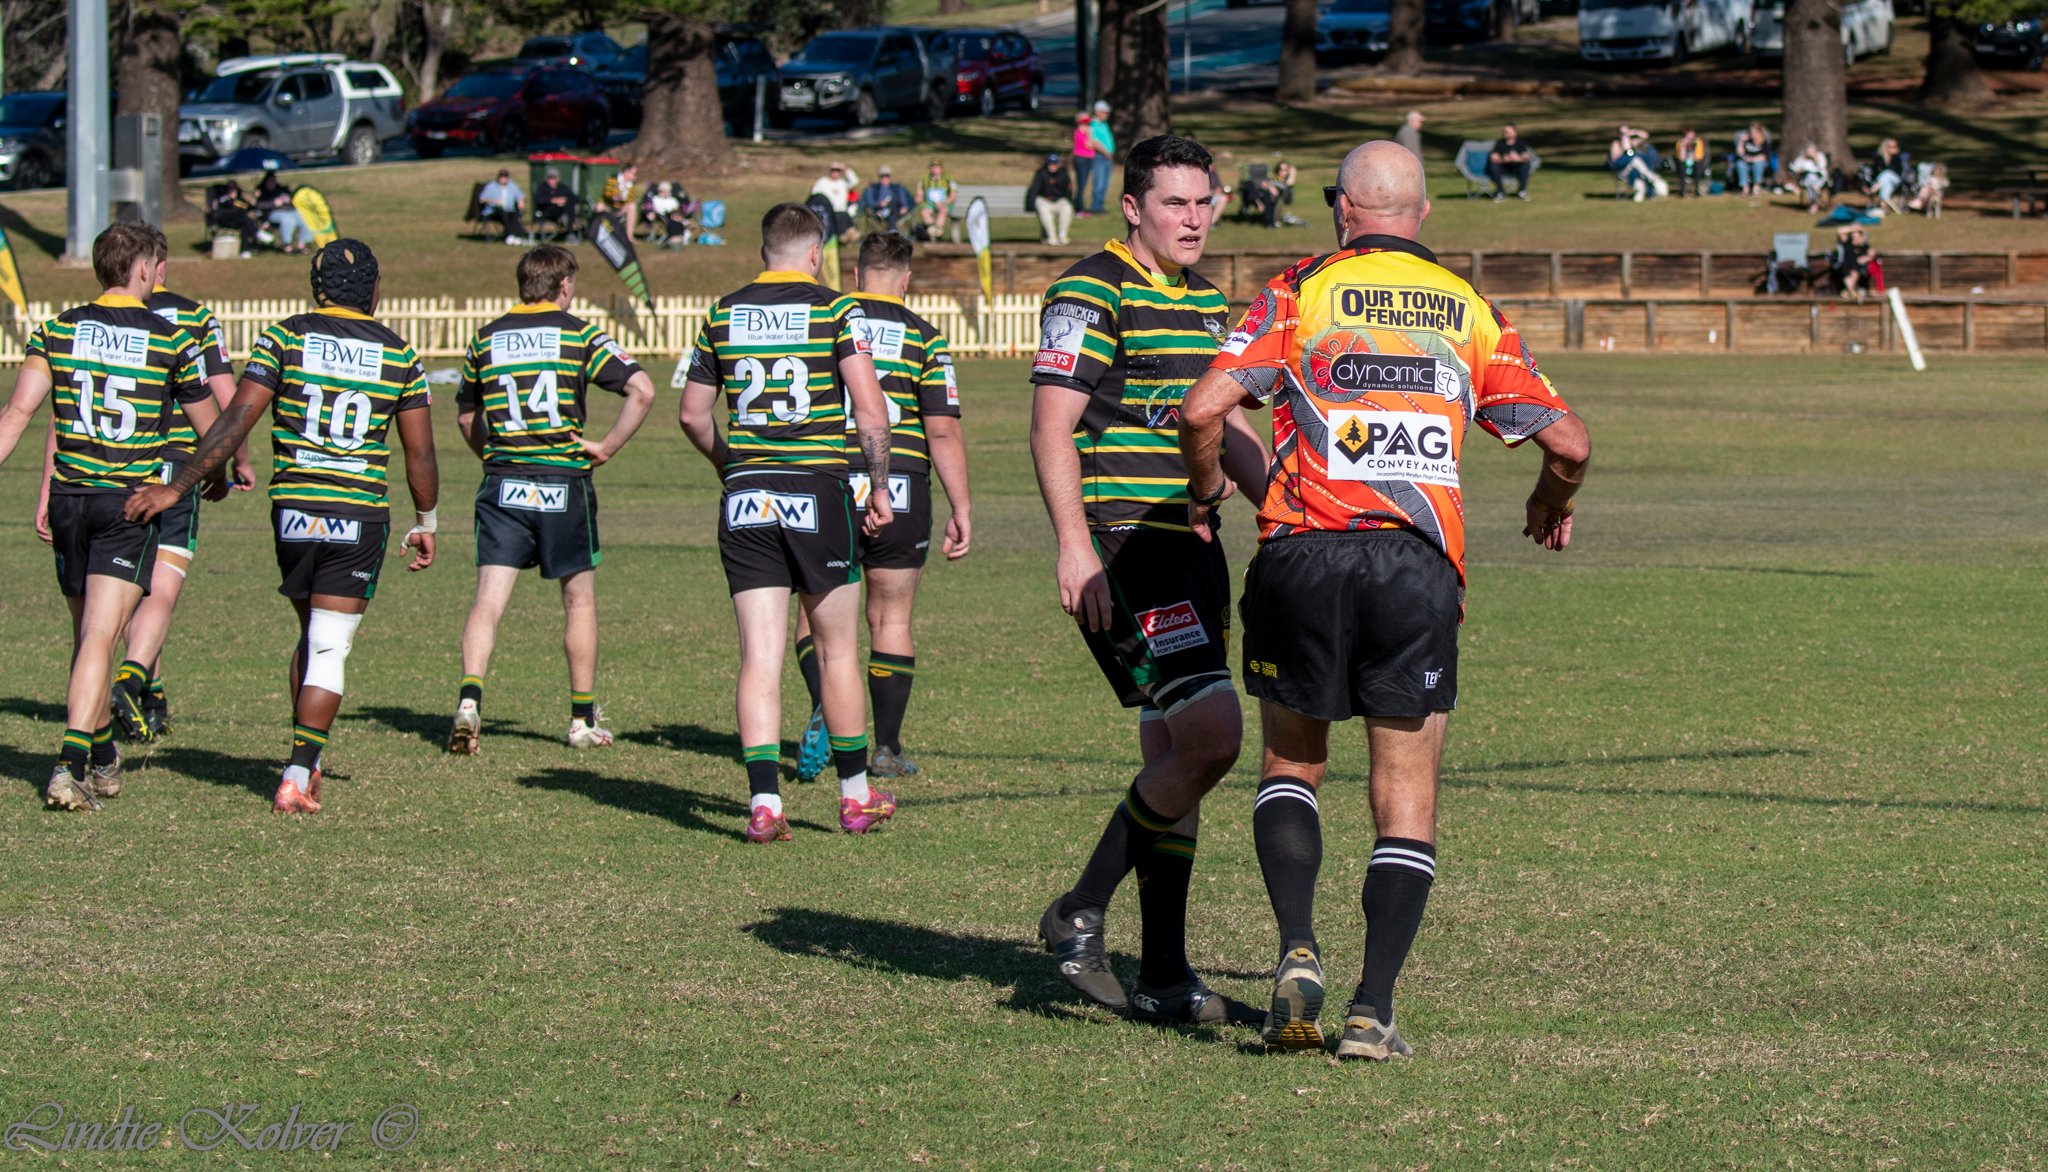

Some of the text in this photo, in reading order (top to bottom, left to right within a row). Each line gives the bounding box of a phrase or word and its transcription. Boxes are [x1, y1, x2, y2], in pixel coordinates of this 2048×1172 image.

[1341, 288, 1466, 333] OUR TOWN
[1365, 308, 1446, 332] FENCING
[786, 332, 805, 341] Legal
[1034, 351, 1070, 367] OOHEYS
[1336, 359, 1433, 386] dynamic
[733, 355, 811, 426] 23
[1362, 382, 1433, 392] dynamic solutions
[72, 368, 138, 442] 15
[498, 369, 563, 432] 14
[302, 382, 373, 450] 10
[1147, 612, 1192, 633] Elders
[1153, 629, 1201, 649] Insurance
